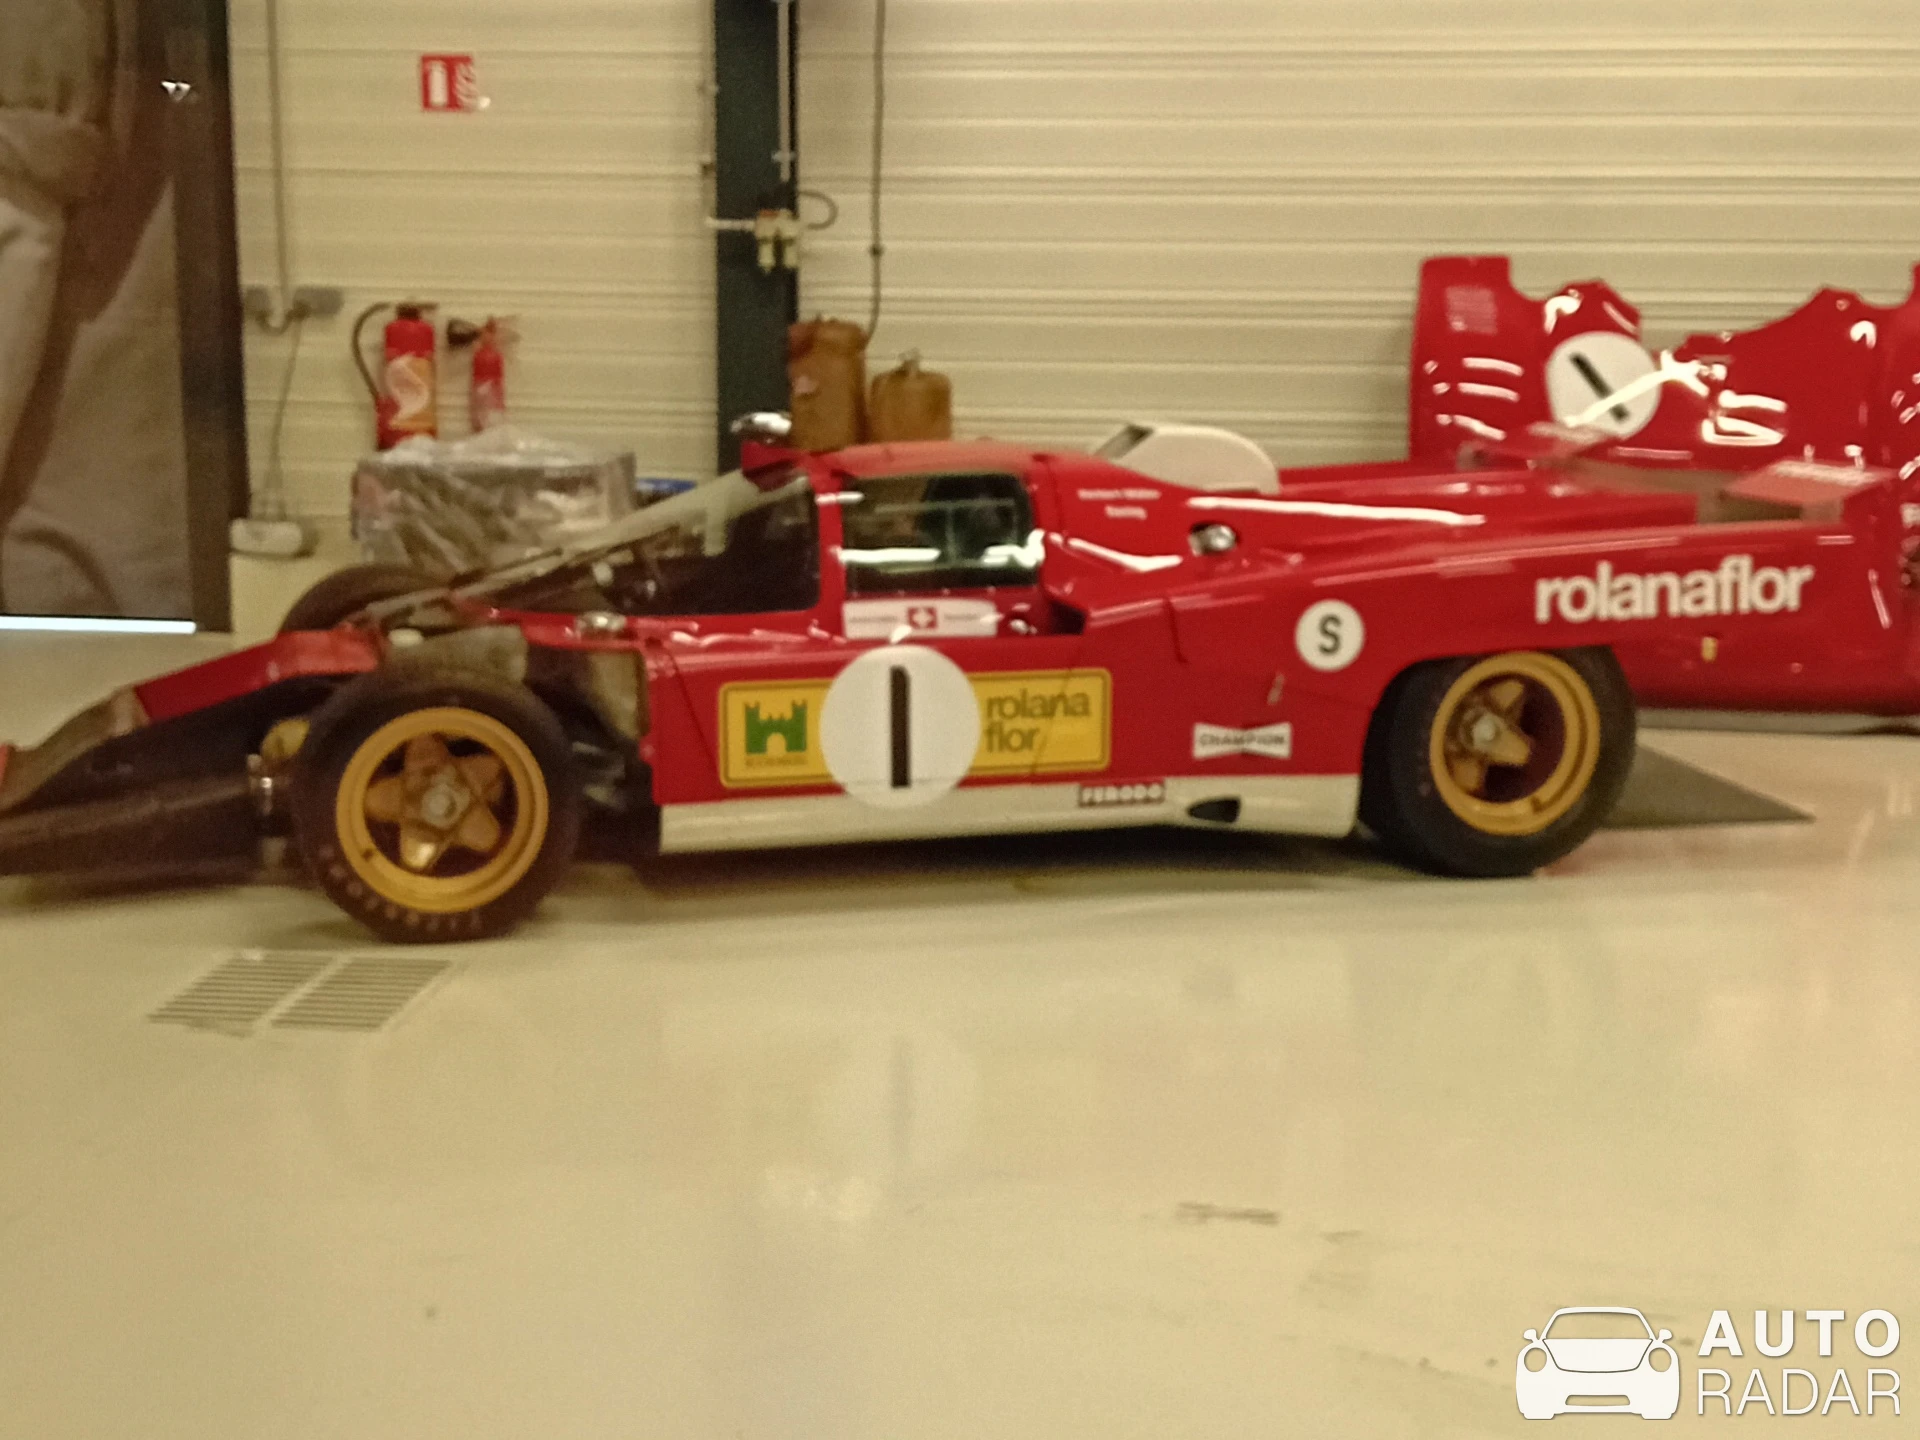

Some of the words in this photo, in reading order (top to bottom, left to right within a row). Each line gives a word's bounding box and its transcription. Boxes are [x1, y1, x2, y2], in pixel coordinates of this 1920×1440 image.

[1535, 554, 1815, 624] rolanaflor
[1319, 613, 1342, 656] S
[986, 688, 1090, 719] rolana
[889, 664, 912, 788] 1
[984, 721, 1040, 753] flor
[1199, 732, 1286, 747] CHAMPION
